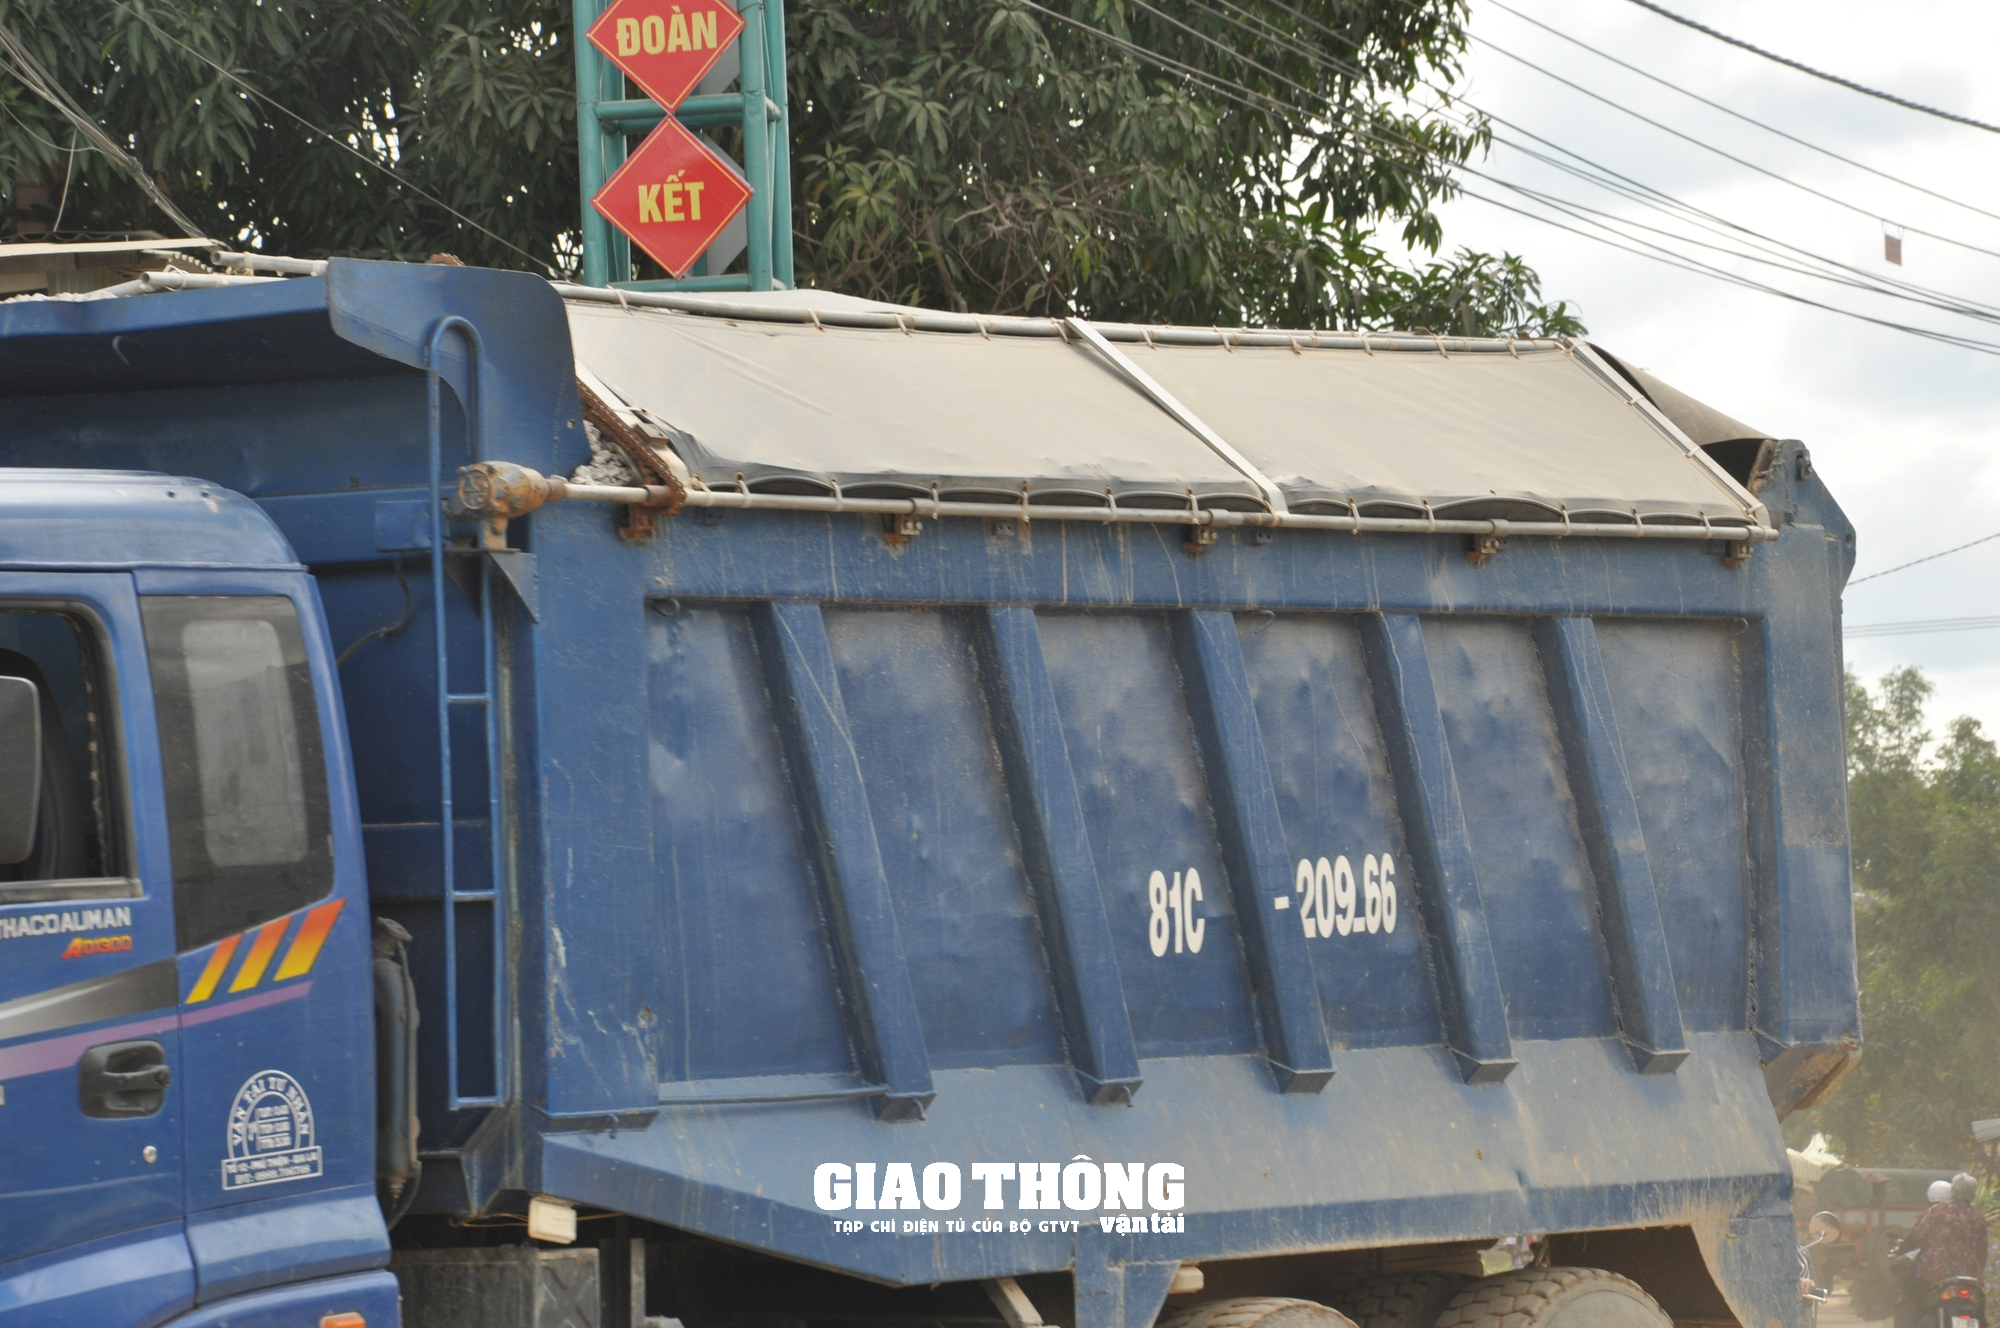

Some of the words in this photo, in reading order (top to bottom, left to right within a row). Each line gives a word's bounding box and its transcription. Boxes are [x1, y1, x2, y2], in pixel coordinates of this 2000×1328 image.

[616, 5, 717, 57] ĐOÀN
[638, 170, 704, 224] KẾT
[1149, 867, 1205, 957] 81C
